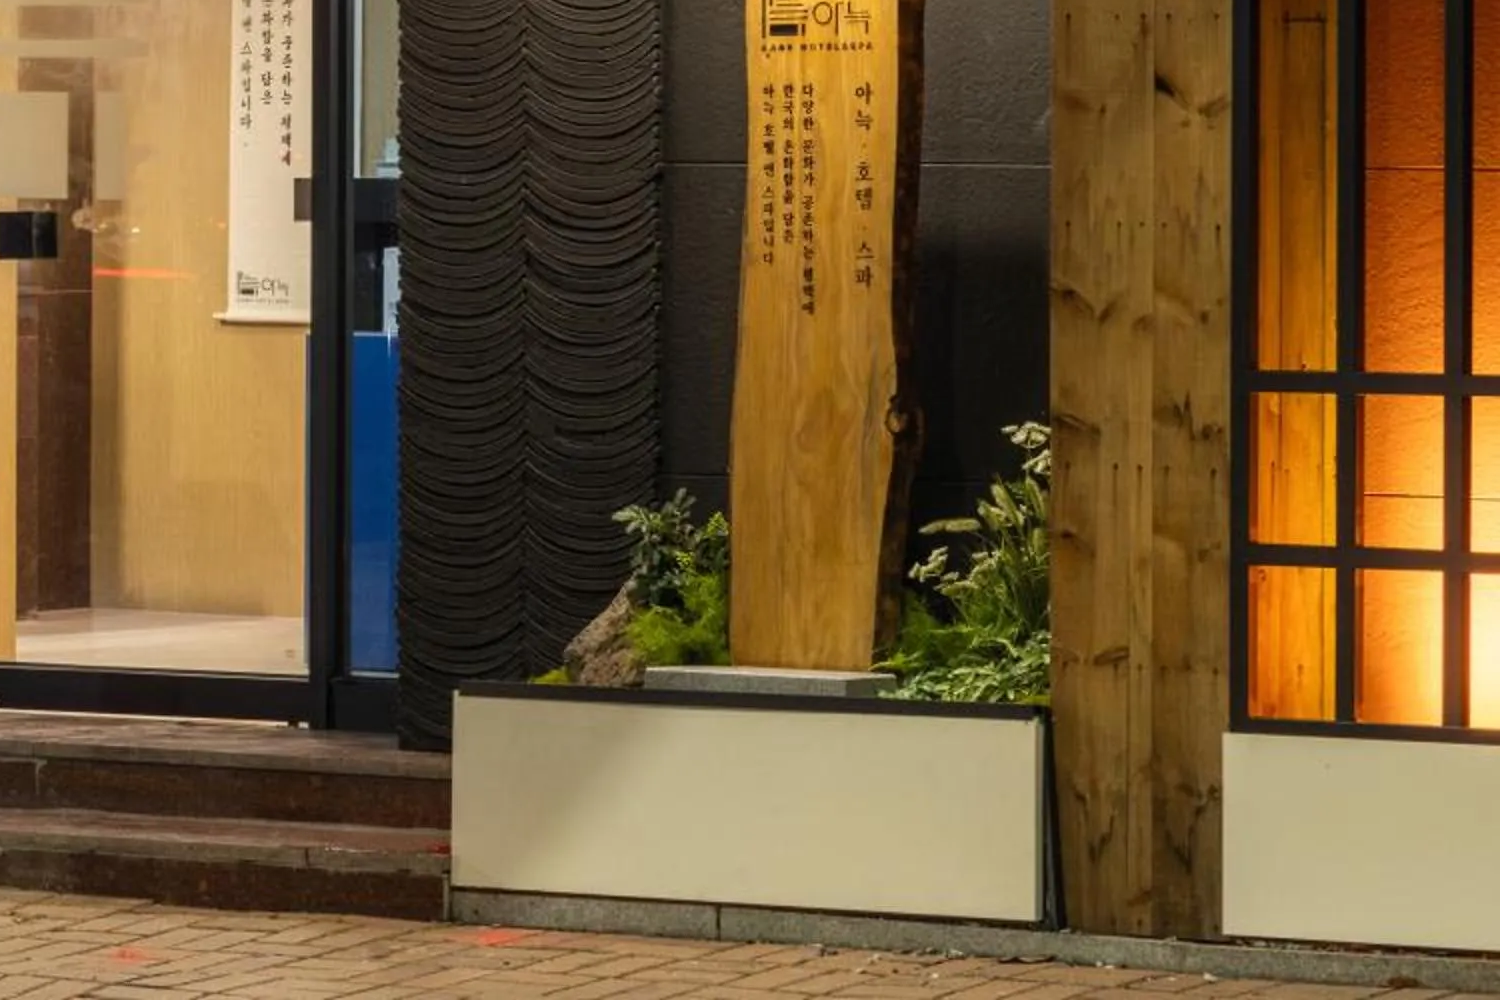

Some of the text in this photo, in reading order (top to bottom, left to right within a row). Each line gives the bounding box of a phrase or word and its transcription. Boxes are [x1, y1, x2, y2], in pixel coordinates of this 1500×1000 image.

[812, 1, 871, 36] 아늑
[802, 81, 815, 130] 다양한
[853, 81, 875, 288] 아늑 호텔 스파
